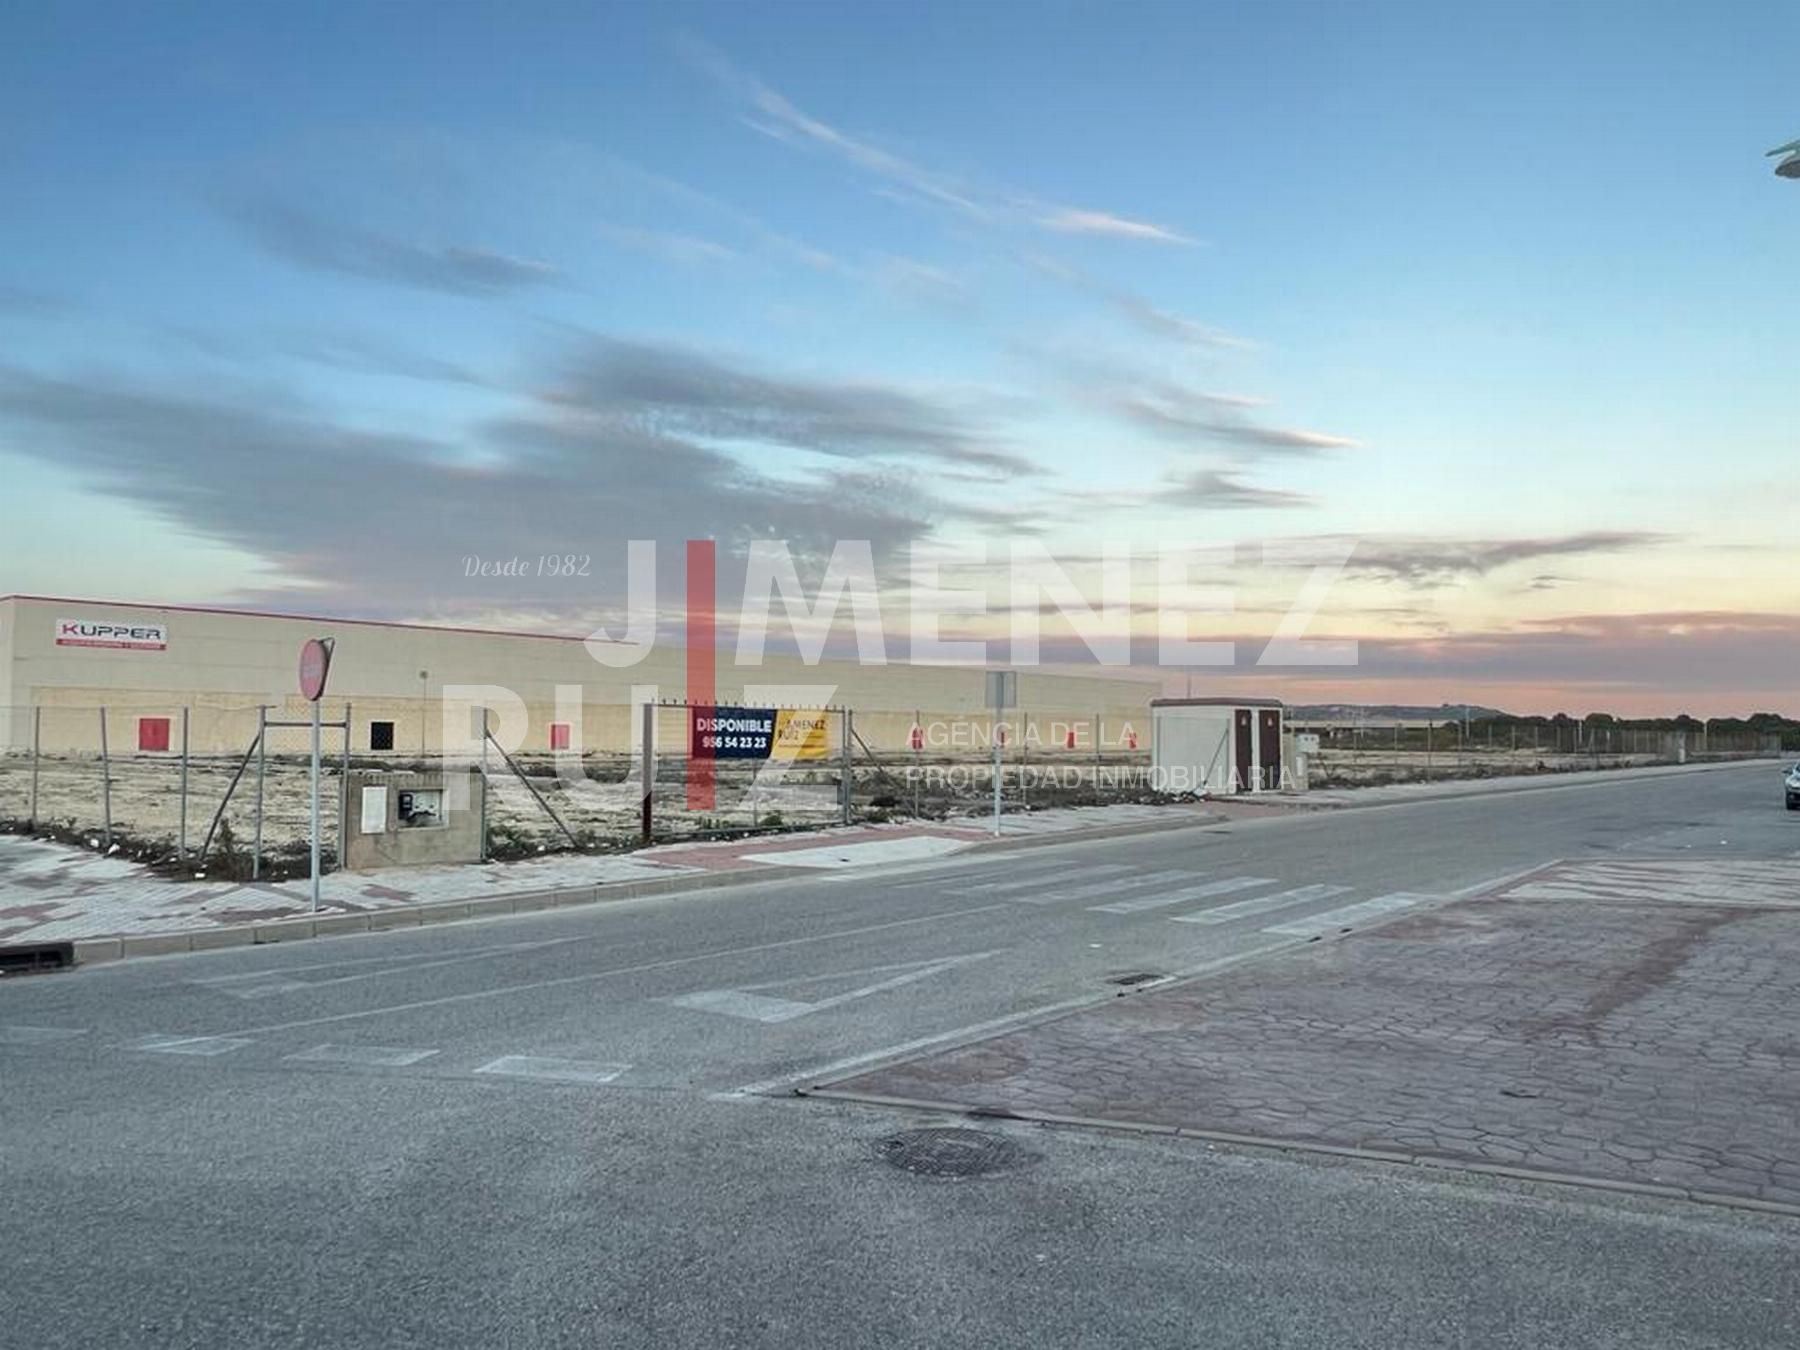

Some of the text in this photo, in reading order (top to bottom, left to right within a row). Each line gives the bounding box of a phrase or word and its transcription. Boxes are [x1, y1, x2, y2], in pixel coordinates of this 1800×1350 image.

[62, 624, 160, 640] KUPPER
[696, 718, 772, 733] DISPONIBLE
[702, 736, 722, 748] 956
[724, 736, 738, 748] 54
[739, 736, 752, 748] 23
[753, 737, 767, 748] 23
